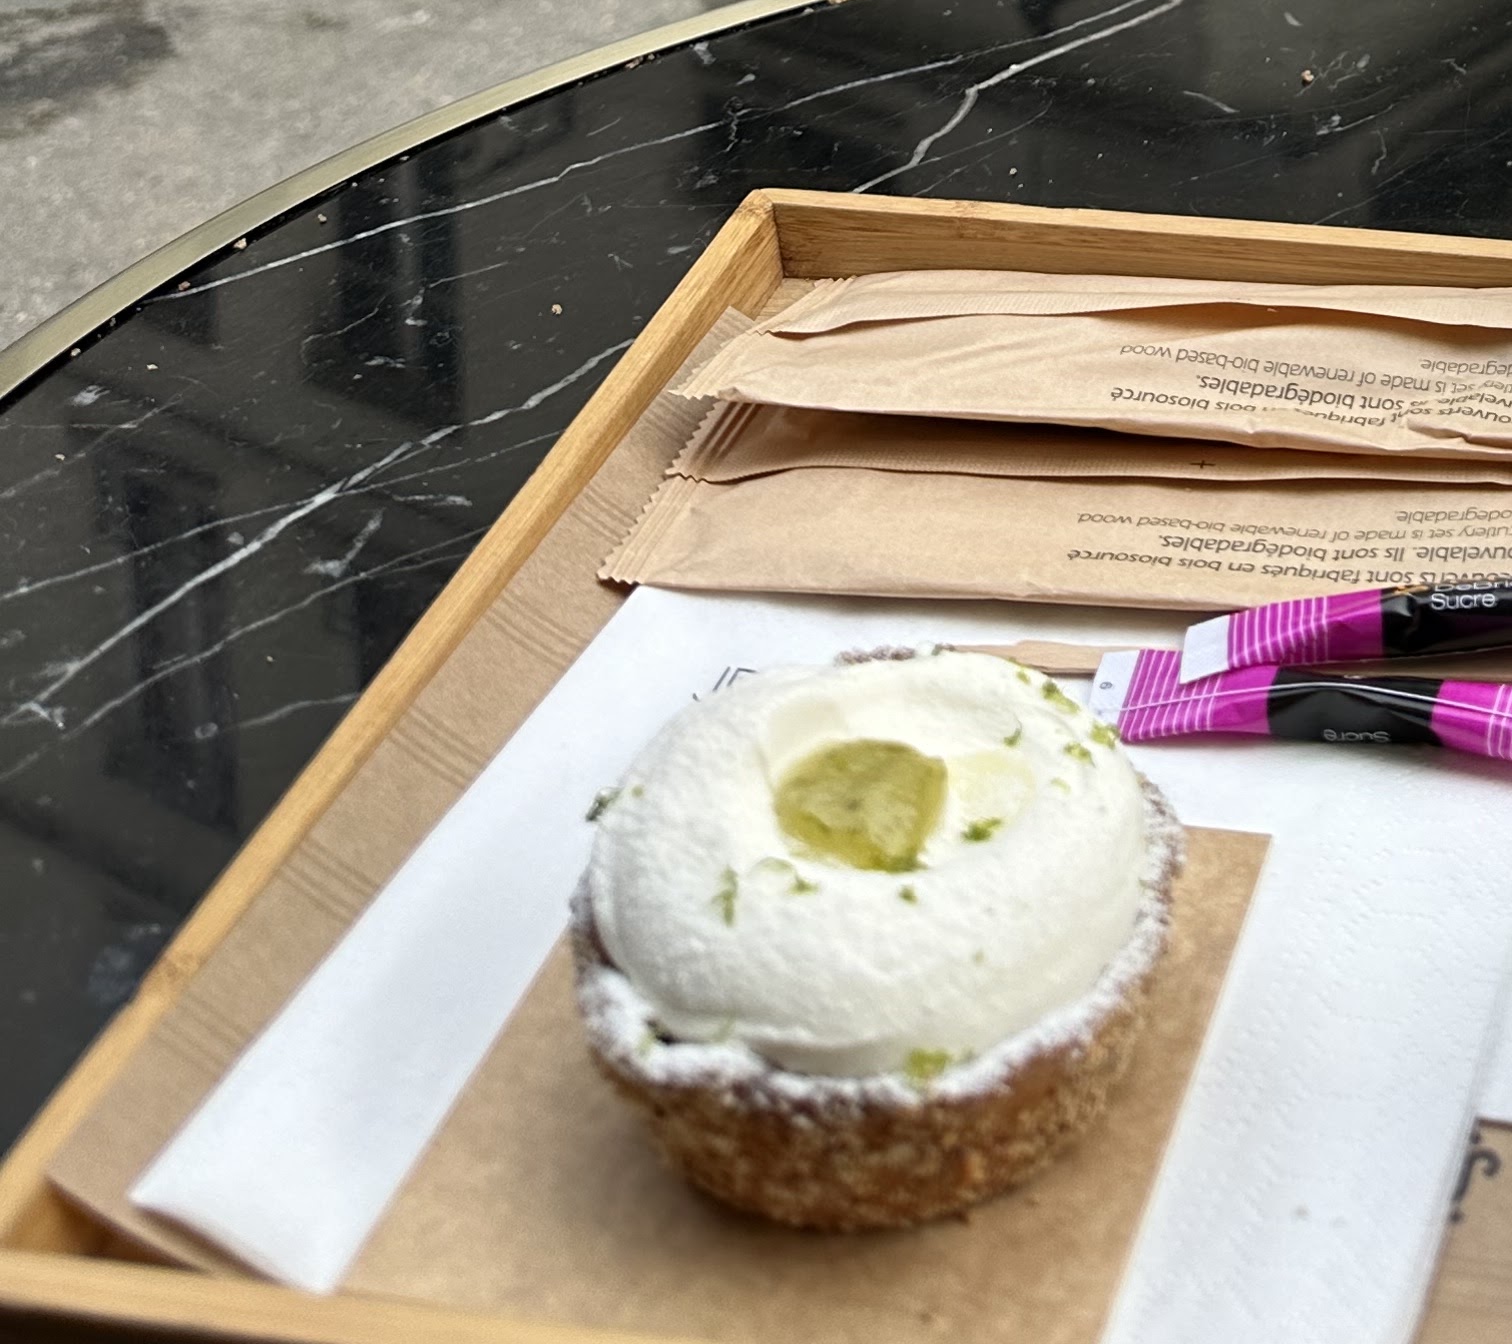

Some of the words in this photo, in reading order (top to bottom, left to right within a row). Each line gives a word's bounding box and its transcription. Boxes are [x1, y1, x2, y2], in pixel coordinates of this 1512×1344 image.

[1174, 348, 1259, 374] bio-based
[1263, 359, 1356, 383] renewable
[1357, 370, 1377, 388] of
[1380, 372, 1430, 392] made
[1435, 380, 1447, 393] is
[1196, 373, 1356, 408] biodégradables.
[1360, 395, 1405, 411] sont
[1136, 515, 1227, 533] bio-based
[1229, 522, 1328, 541] renewable
[1329, 527, 1351, 543] of
[1353, 528, 1407, 541] made
[1411, 528, 1424, 540] is
[1427, 527, 1456, 540] set
[1158, 534, 1328, 562] biodégradables.
[1331, 546, 1381, 562] sont
[1384, 546, 1405, 562] Ils
[1066, 548, 1173, 567] biosourcé
[1177, 556, 1222, 572] bois
[1227, 562, 1256, 574] en
[1260, 562, 1362, 584] fabriqués
[1366, 569, 1415, 585] sont
[1430, 592, 1498, 611] Sucre
[1322, 728, 1391, 743] Sucre
